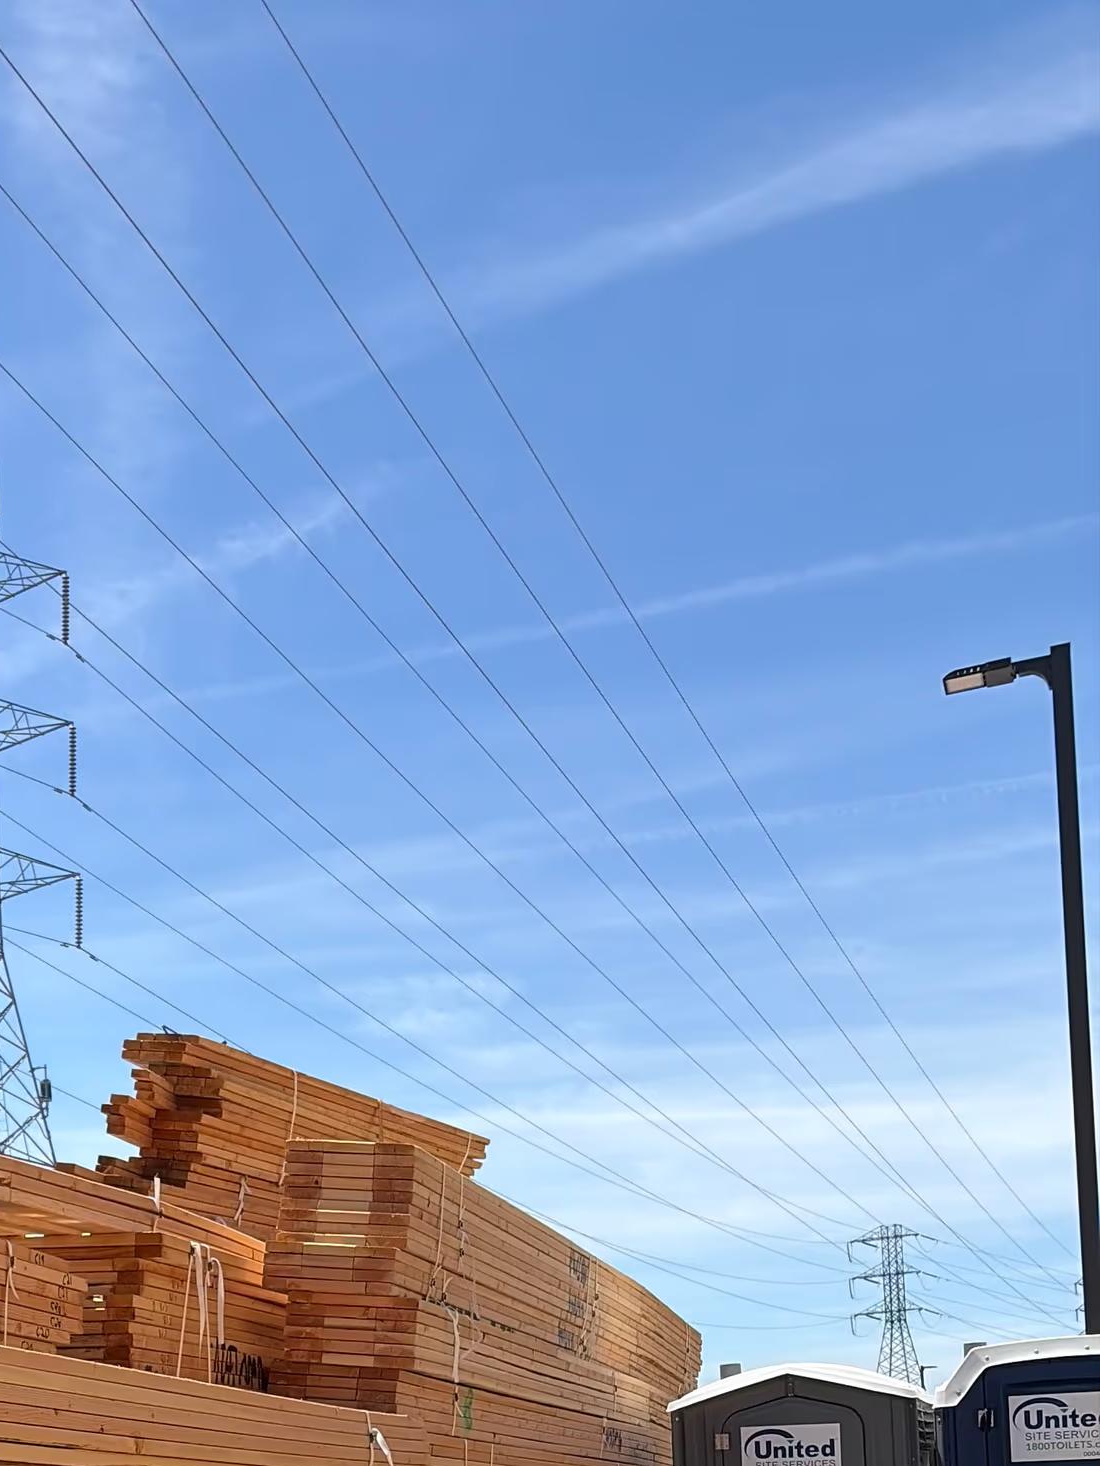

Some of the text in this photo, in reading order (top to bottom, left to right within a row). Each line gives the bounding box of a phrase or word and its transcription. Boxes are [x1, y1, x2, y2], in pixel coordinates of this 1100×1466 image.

[1024, 1408, 1100, 1430] Unite
[1025, 1431, 1051, 1441] SITE
[754, 1438, 835, 1459] United
